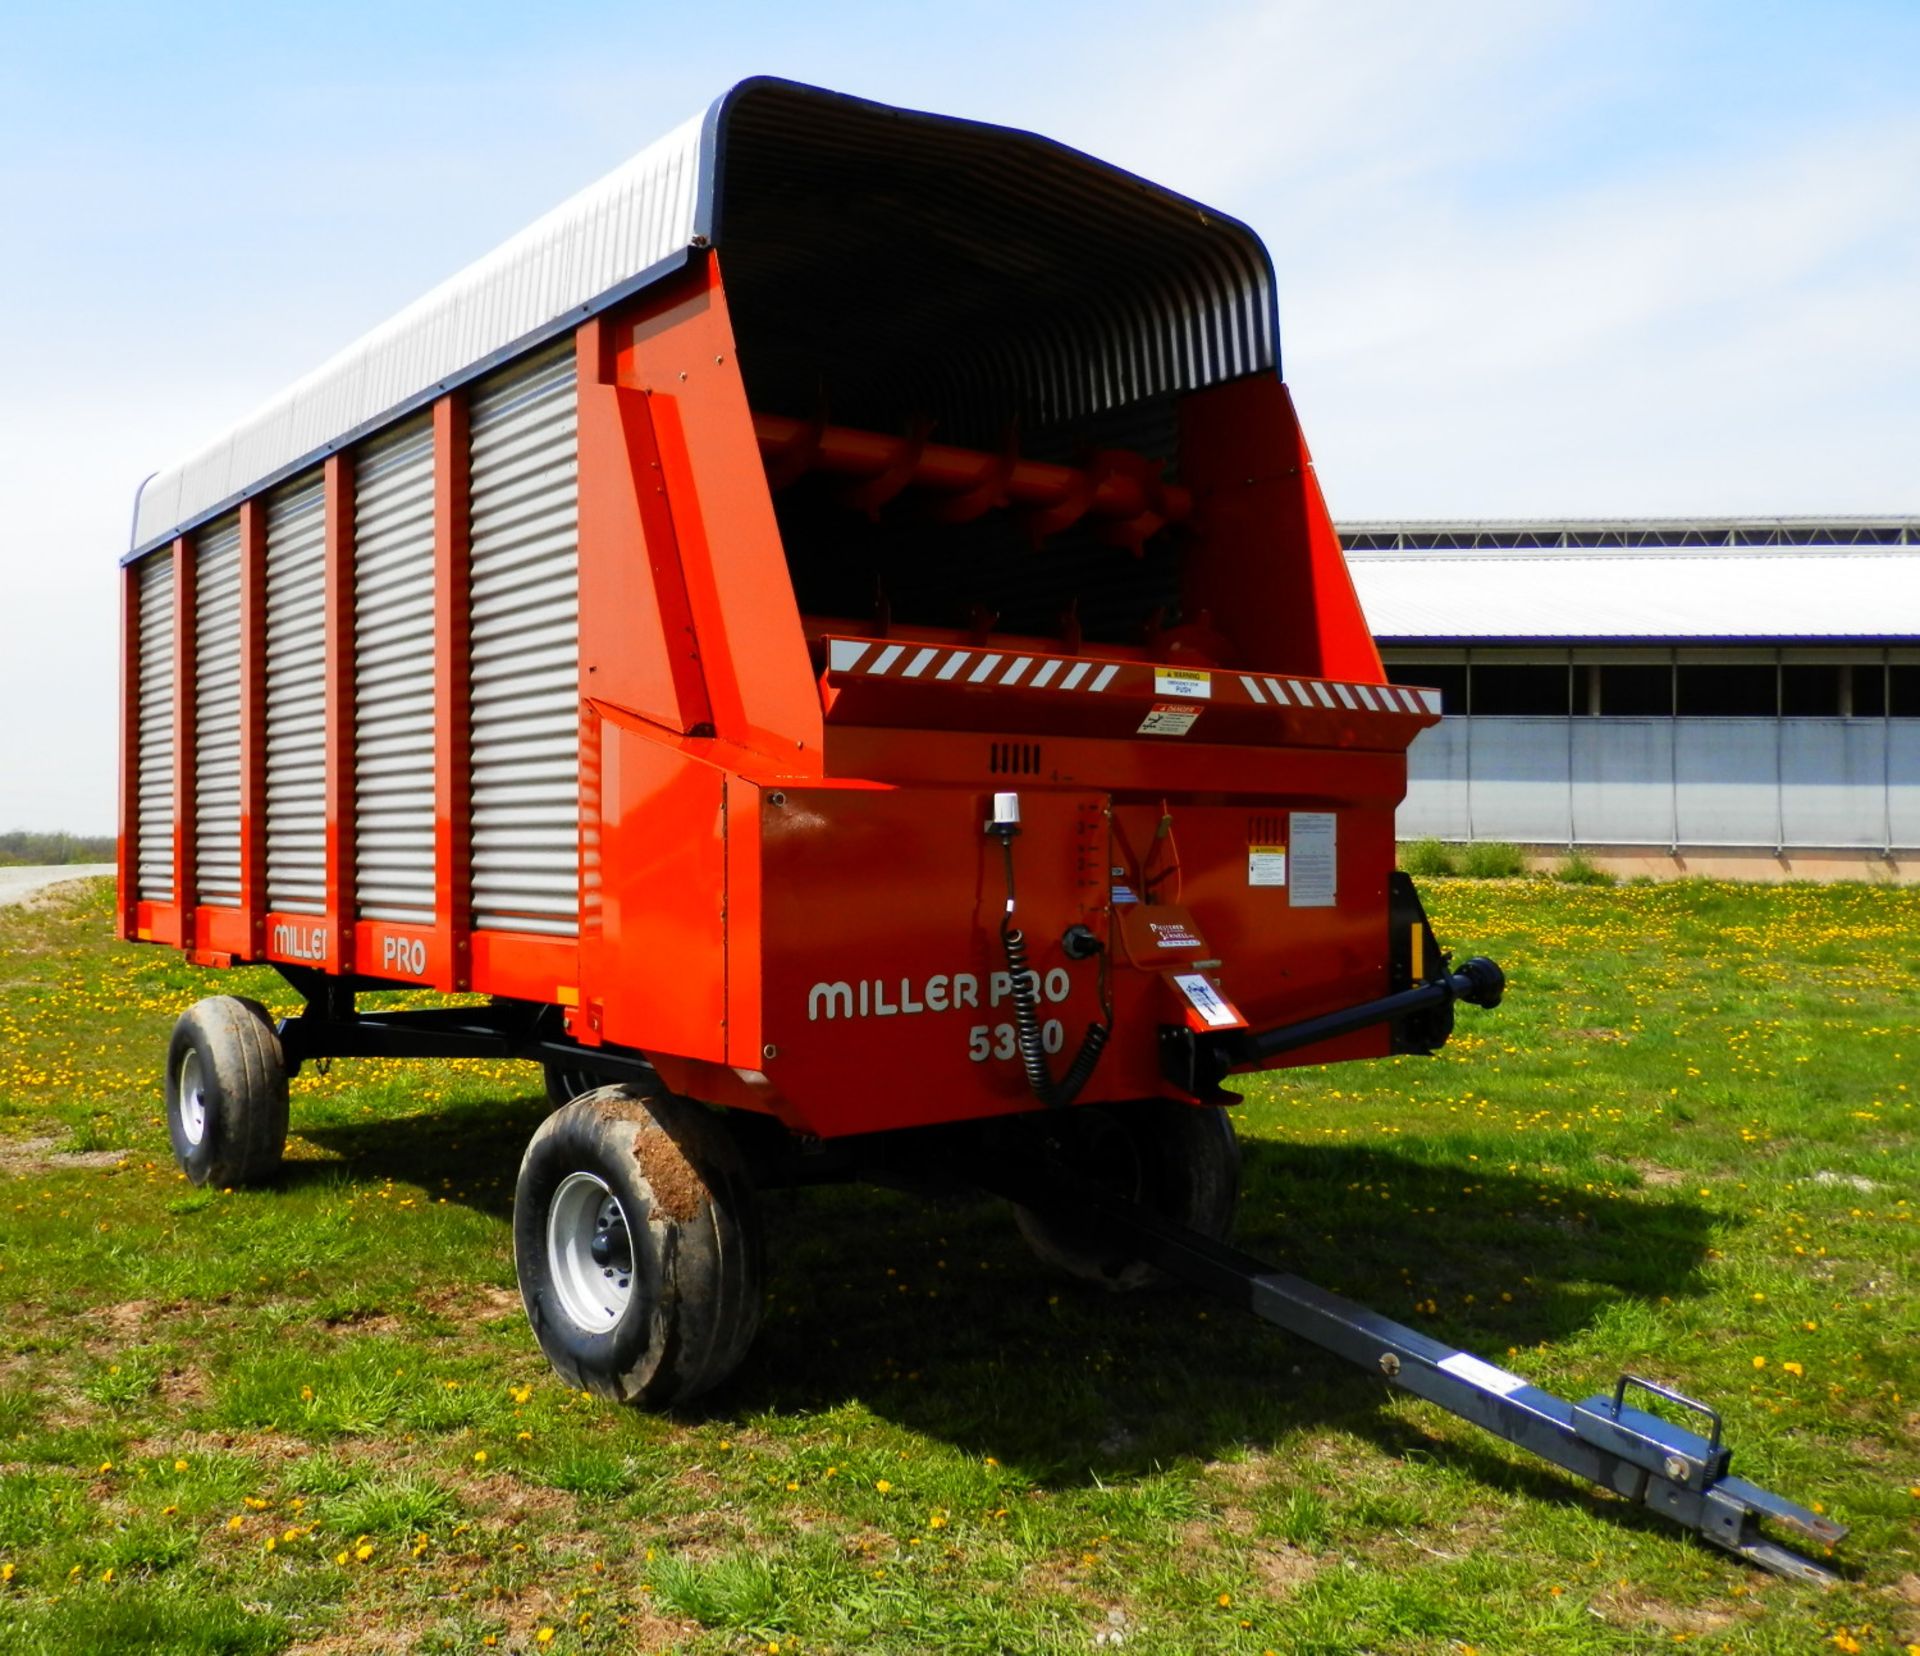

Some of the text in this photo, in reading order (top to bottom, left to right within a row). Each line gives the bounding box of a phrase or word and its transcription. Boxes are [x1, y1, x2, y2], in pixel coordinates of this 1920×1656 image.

[1174, 672, 1200, 680] WARNING
[1167, 705, 1195, 713] DANGER
[384, 936, 426, 976] PRO
[808, 972, 979, 1021] MILLER
[968, 1019, 1064, 1062] 530
